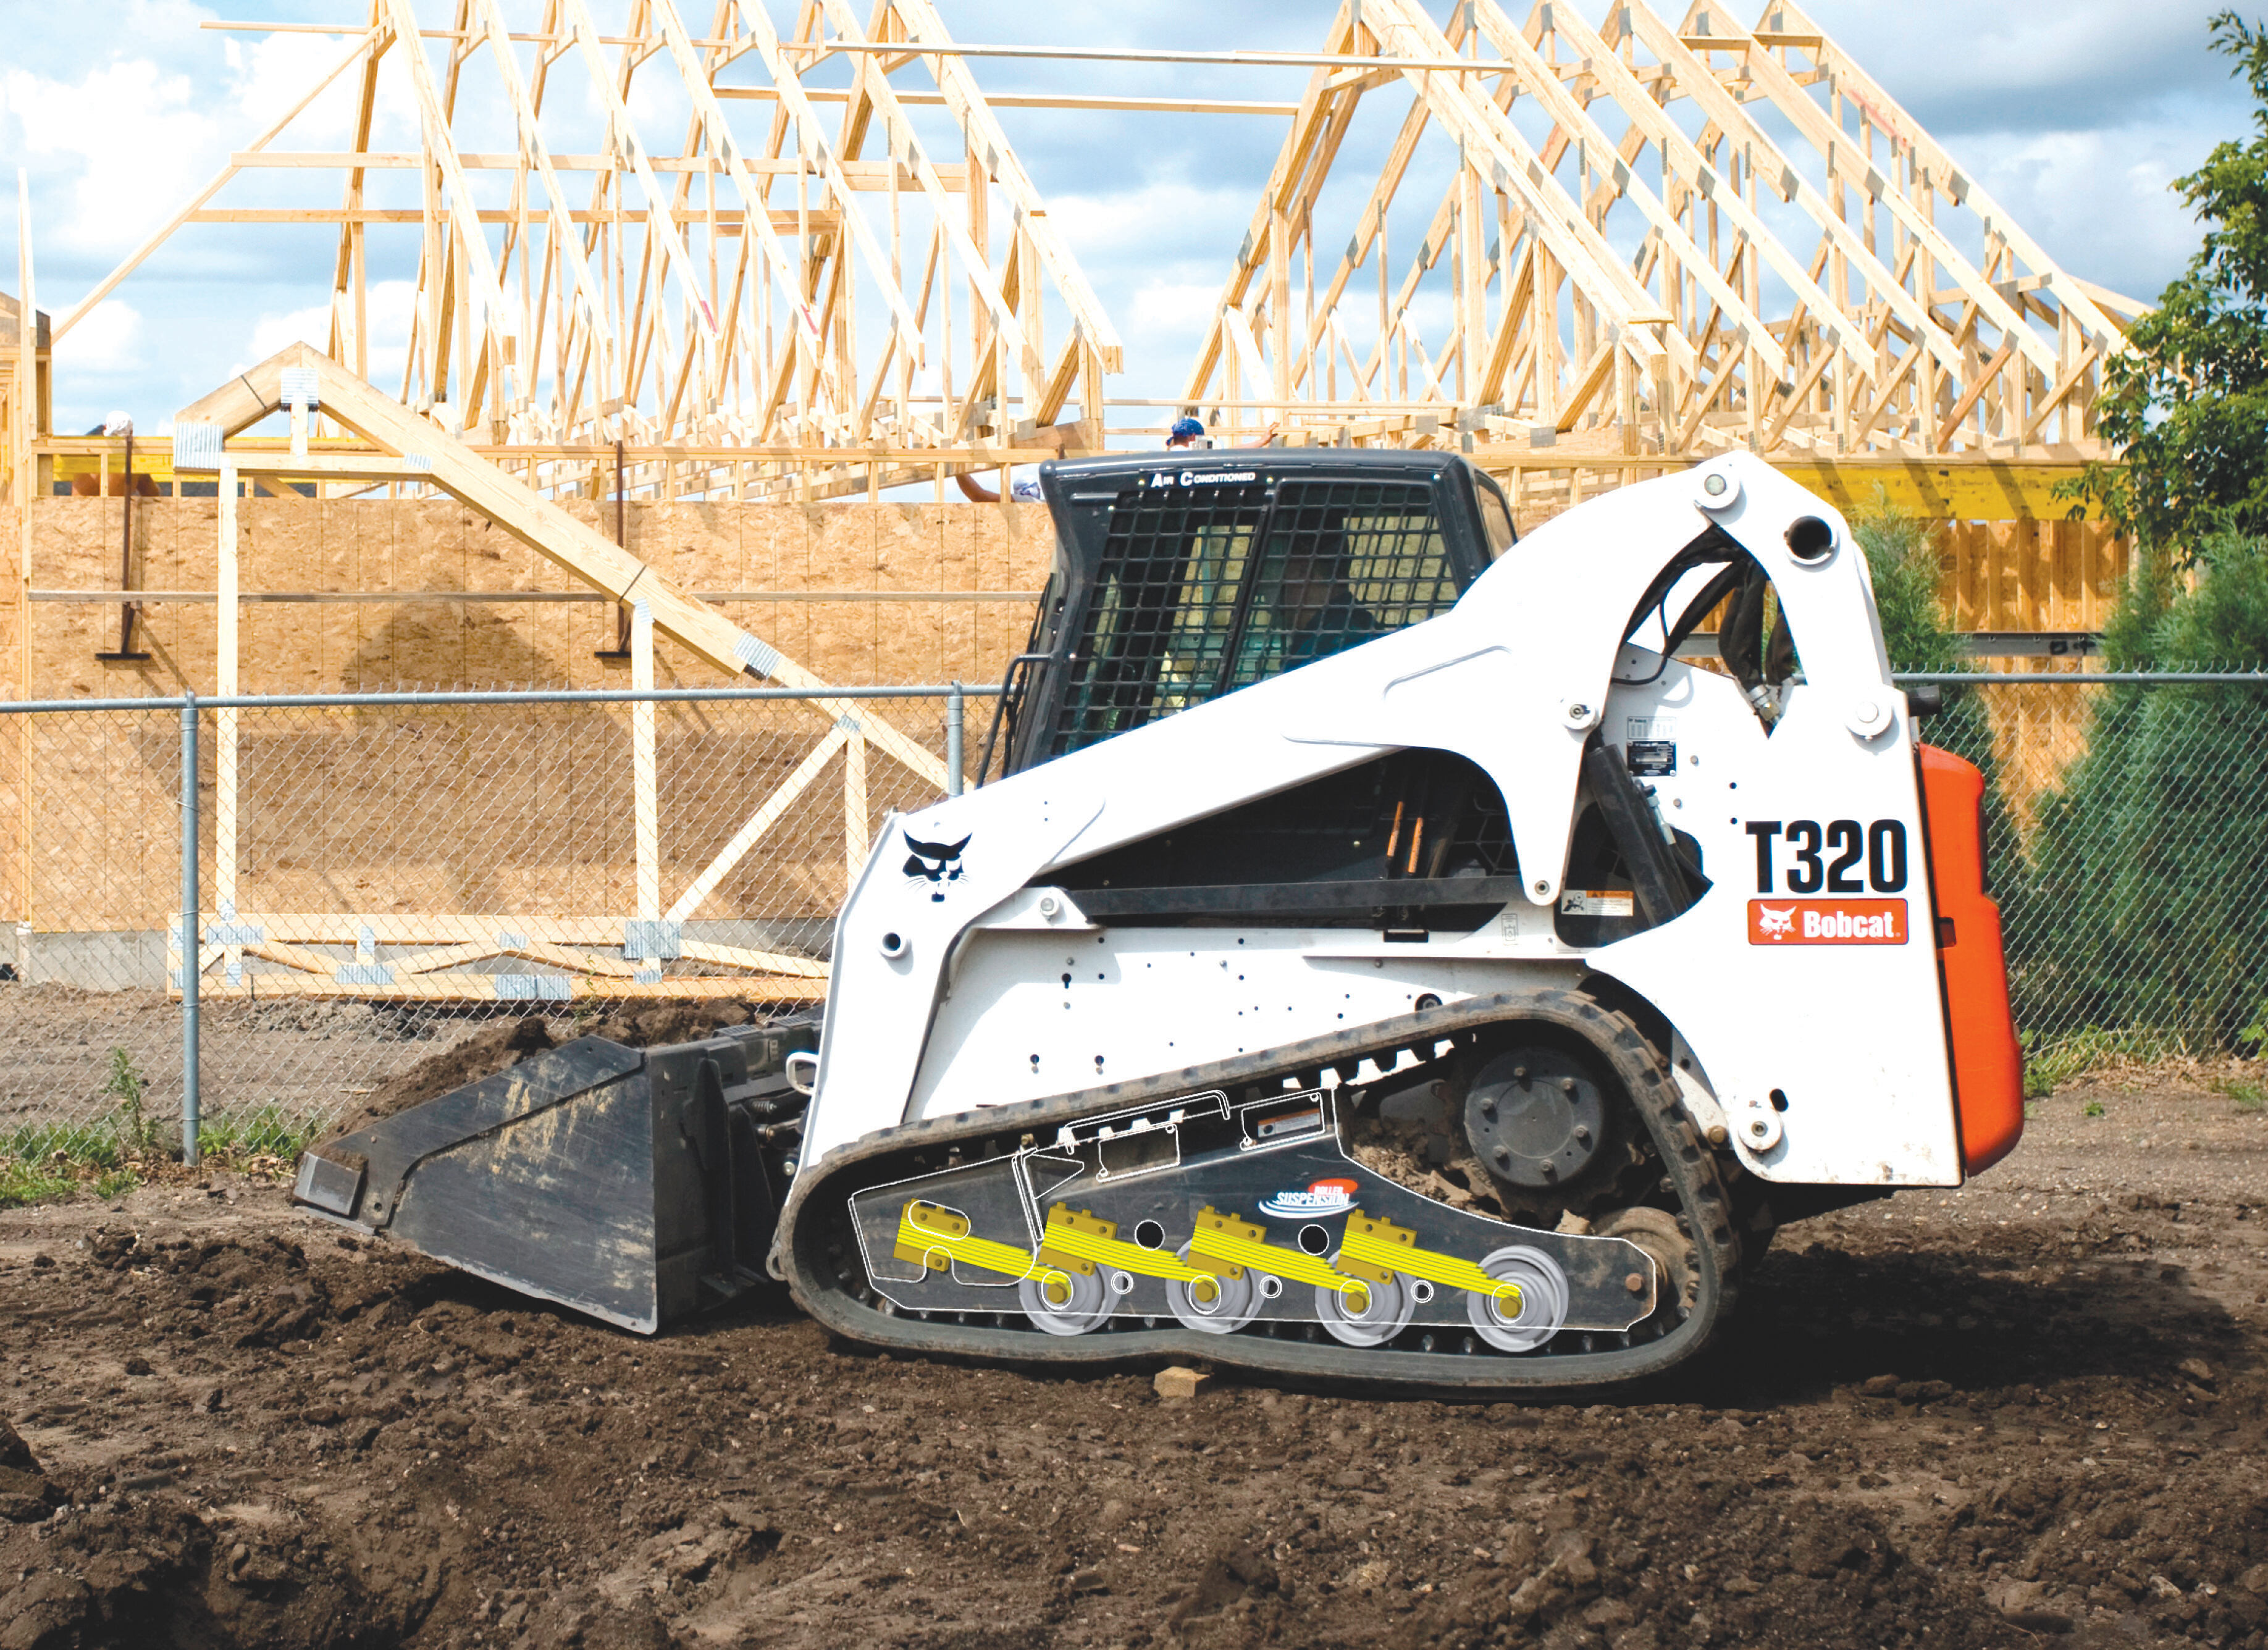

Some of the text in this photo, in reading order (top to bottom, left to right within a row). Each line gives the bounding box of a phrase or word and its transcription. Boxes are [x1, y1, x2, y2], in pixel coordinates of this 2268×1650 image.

[1180, 472, 1256, 487] CONDITIONED
[1745, 819, 1908, 893] T320
[1804, 910, 1894, 938] Bobcat
[1314, 1186, 1343, 1196] ROLLER
[1276, 1192, 1350, 1206] SUSPENSION
